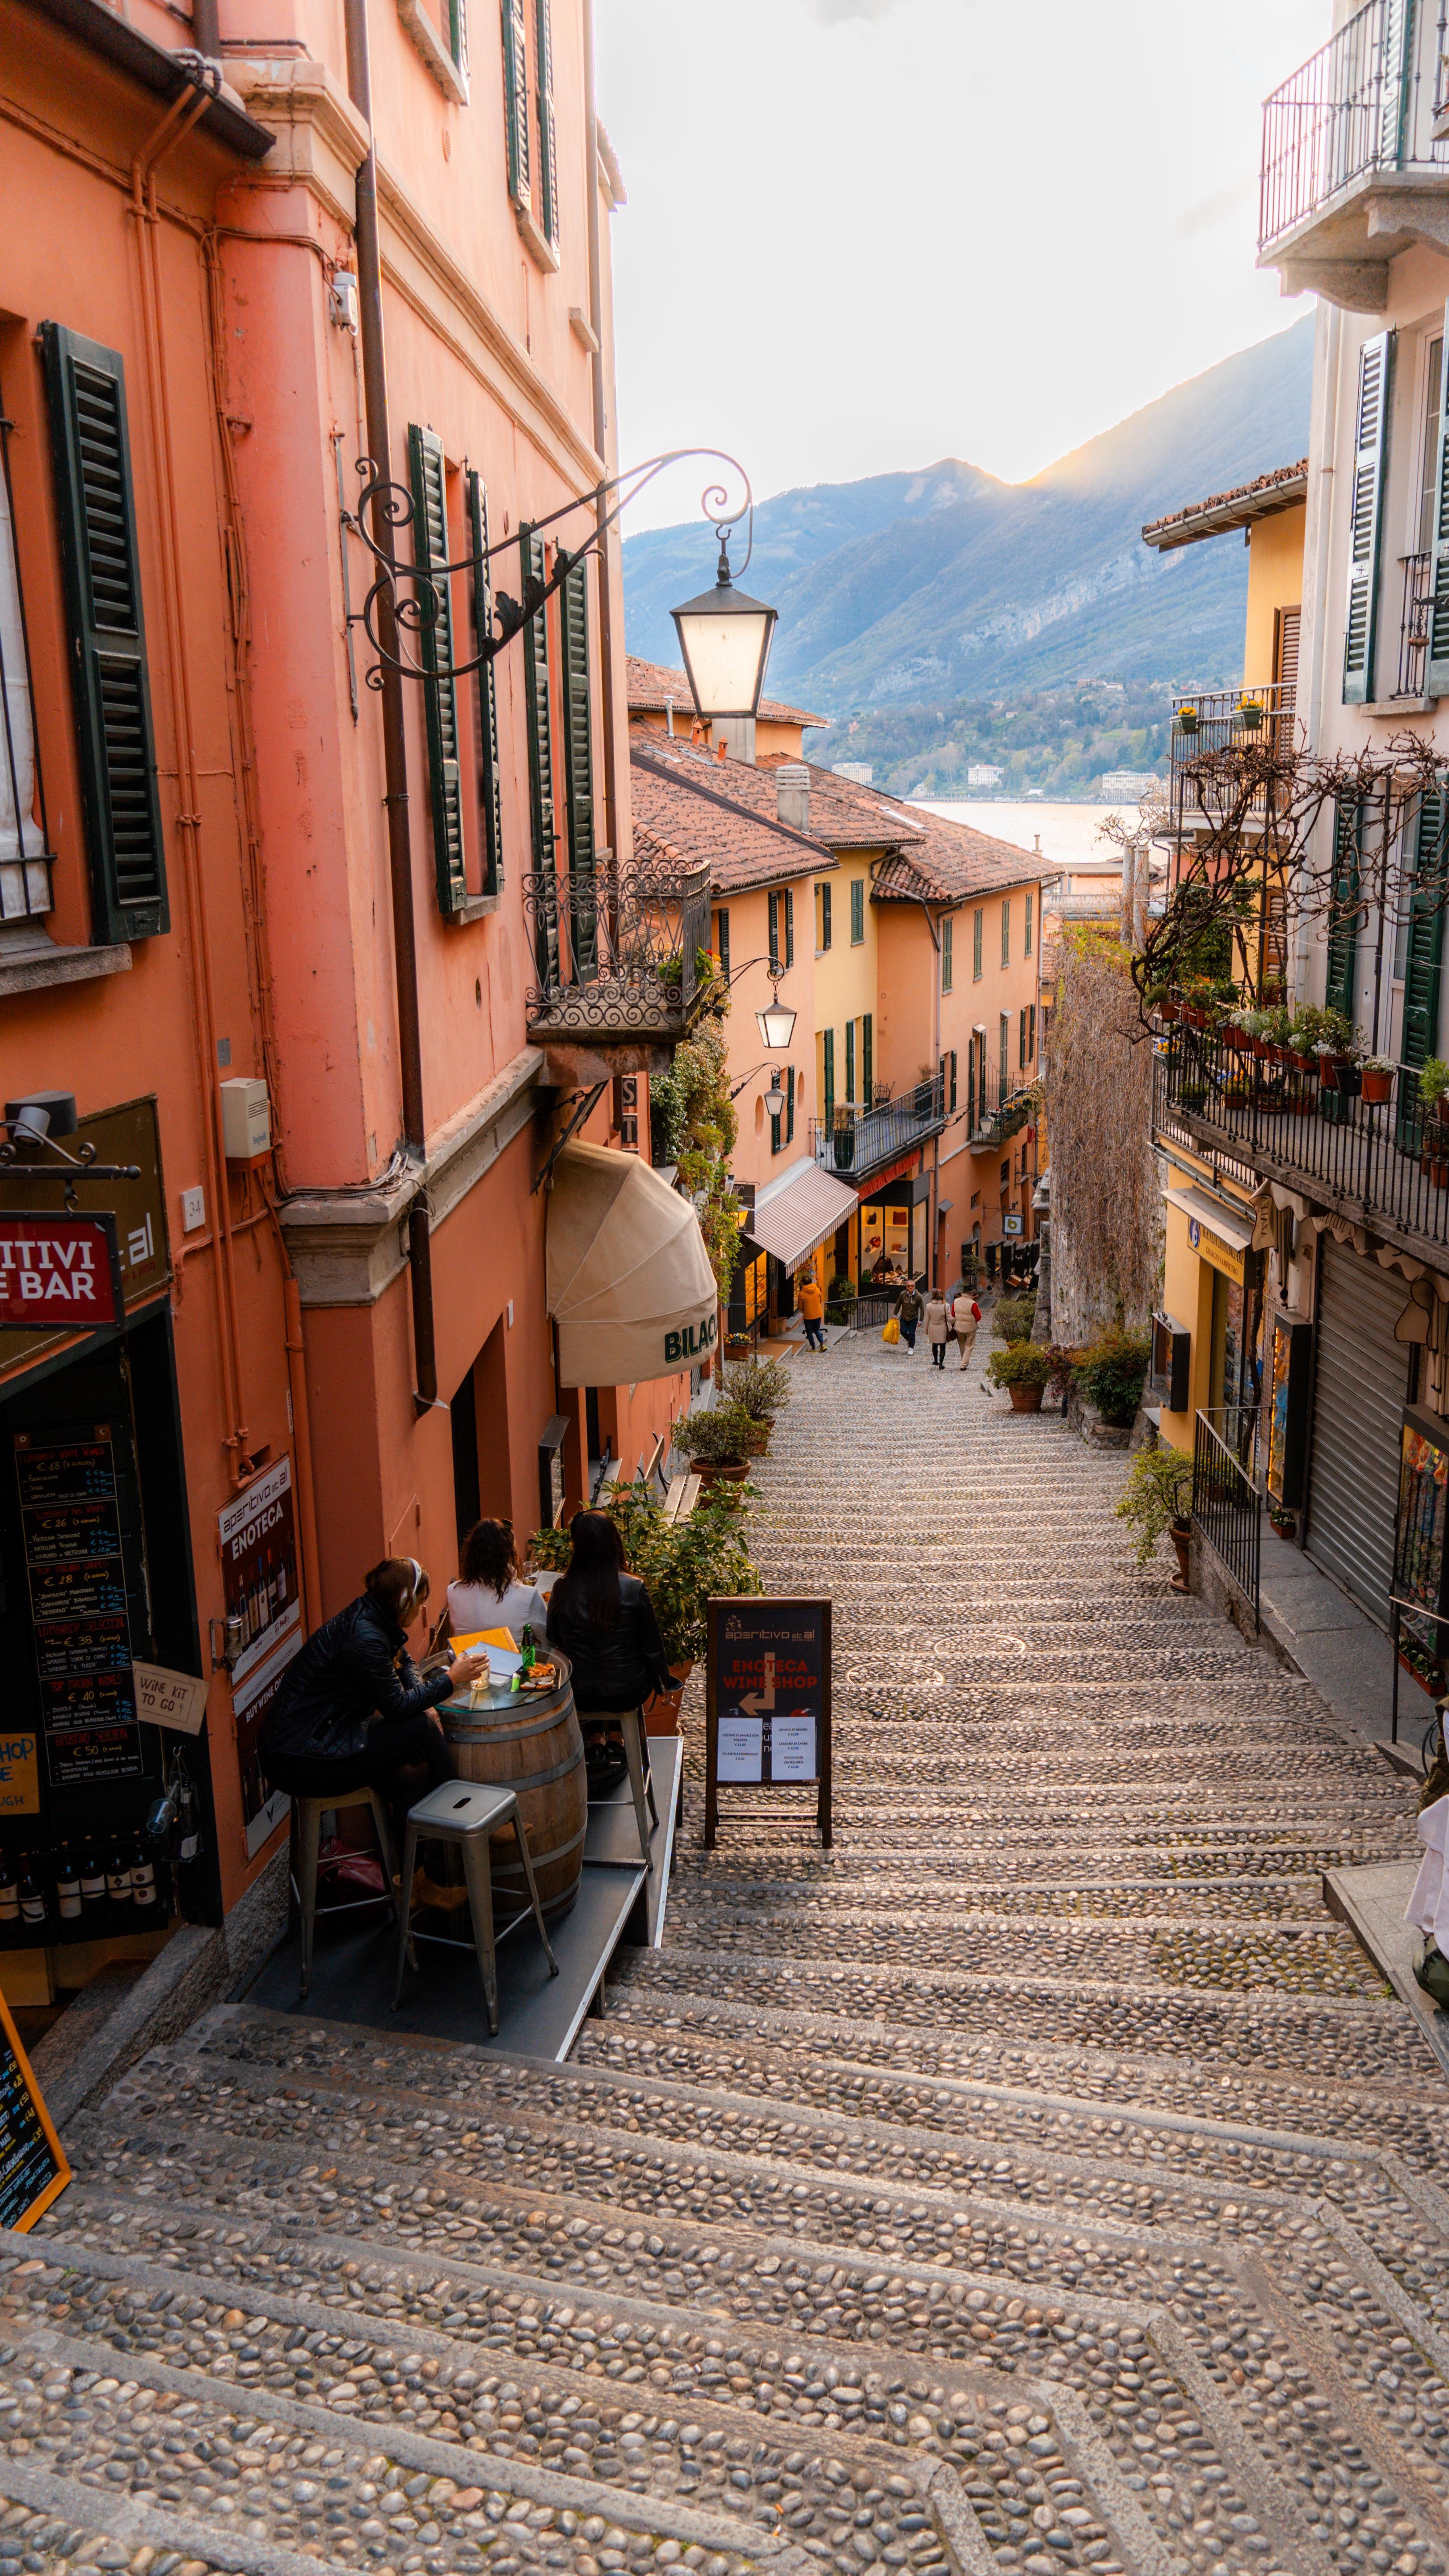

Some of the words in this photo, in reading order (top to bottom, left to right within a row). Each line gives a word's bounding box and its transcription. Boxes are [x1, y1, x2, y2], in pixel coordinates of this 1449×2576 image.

[190, 1200, 201, 1216] 34
[1202, 1227, 1217, 1247] AGENZIA
[1218, 1237, 1244, 1266] IMMOBILIARE
[1206, 1246, 1219, 1262] GIORGIO
[1219, 1255, 1238, 1276] SAMPIETRO
[20, 1271, 97, 1300] BAR
[36, 1462, 46, 1471] €
[48, 1462, 60, 1471] 18
[224, 1485, 270, 1533] aperitivo
[280, 1466, 287, 1486] al
[42, 1520, 52, 1528] €
[55, 1519, 67, 1527] 26
[232, 1500, 284, 1561] ENOTECA
[44, 1577, 55, 1587] €
[59, 1574, 73, 1585] 28
[64, 1637, 75, 1647] €
[78, 1635, 93, 1645] 38
[725, 1629, 790, 1642] aperitivo
[804, 1629, 815, 1639] al
[732, 1659, 809, 1673] ENOTECA
[722, 1676, 767, 1689] WINE
[771, 1676, 818, 1689] SHOP
[67, 1692, 77, 1702] €
[82, 1691, 95, 1701] 40
[142, 1692, 155, 1705] TO
[160, 1698, 175, 1711] GO
[246, 1702, 259, 1724] BUY
[257, 1685, 274, 1709] WINE
[72, 1747, 82, 1757] €
[84, 1745, 99, 1755] 50
